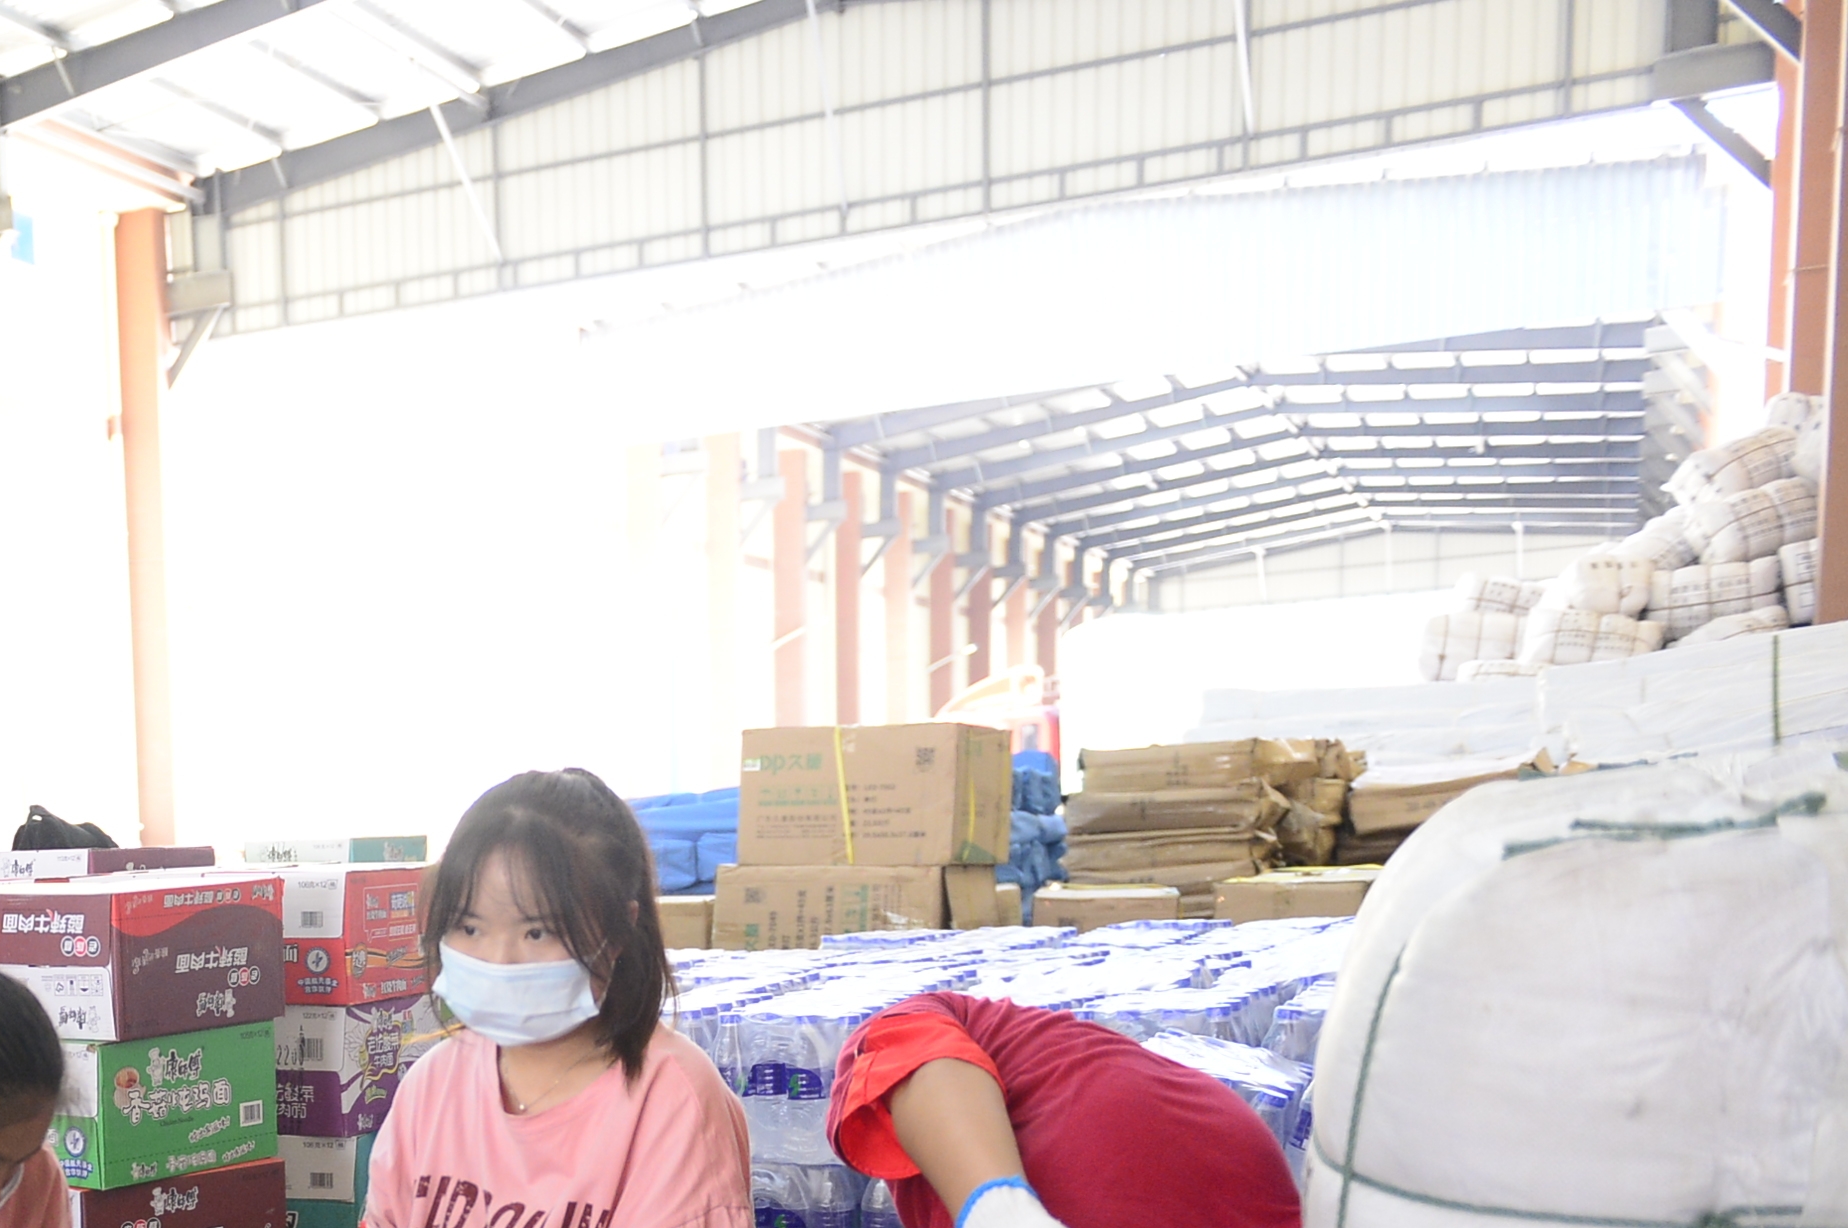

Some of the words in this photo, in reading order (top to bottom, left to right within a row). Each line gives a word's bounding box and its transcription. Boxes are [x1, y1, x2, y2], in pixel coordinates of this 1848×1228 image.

[10, 858, 36, 876] 康师傅
[163, 891, 214, 907] 酸辣牛肉面
[1, 909, 85, 933] 酸辣牛肉面
[175, 945, 249, 974] 酸辣牛肉面
[195, 991, 226, 1017] 康师傅
[57, 1006, 87, 1030] 康师傅
[164, 1048, 203, 1082] 康师傅
[122, 1079, 232, 1126] 香菇炖鸡面
[165, 1186, 199, 1214] 康师傅
